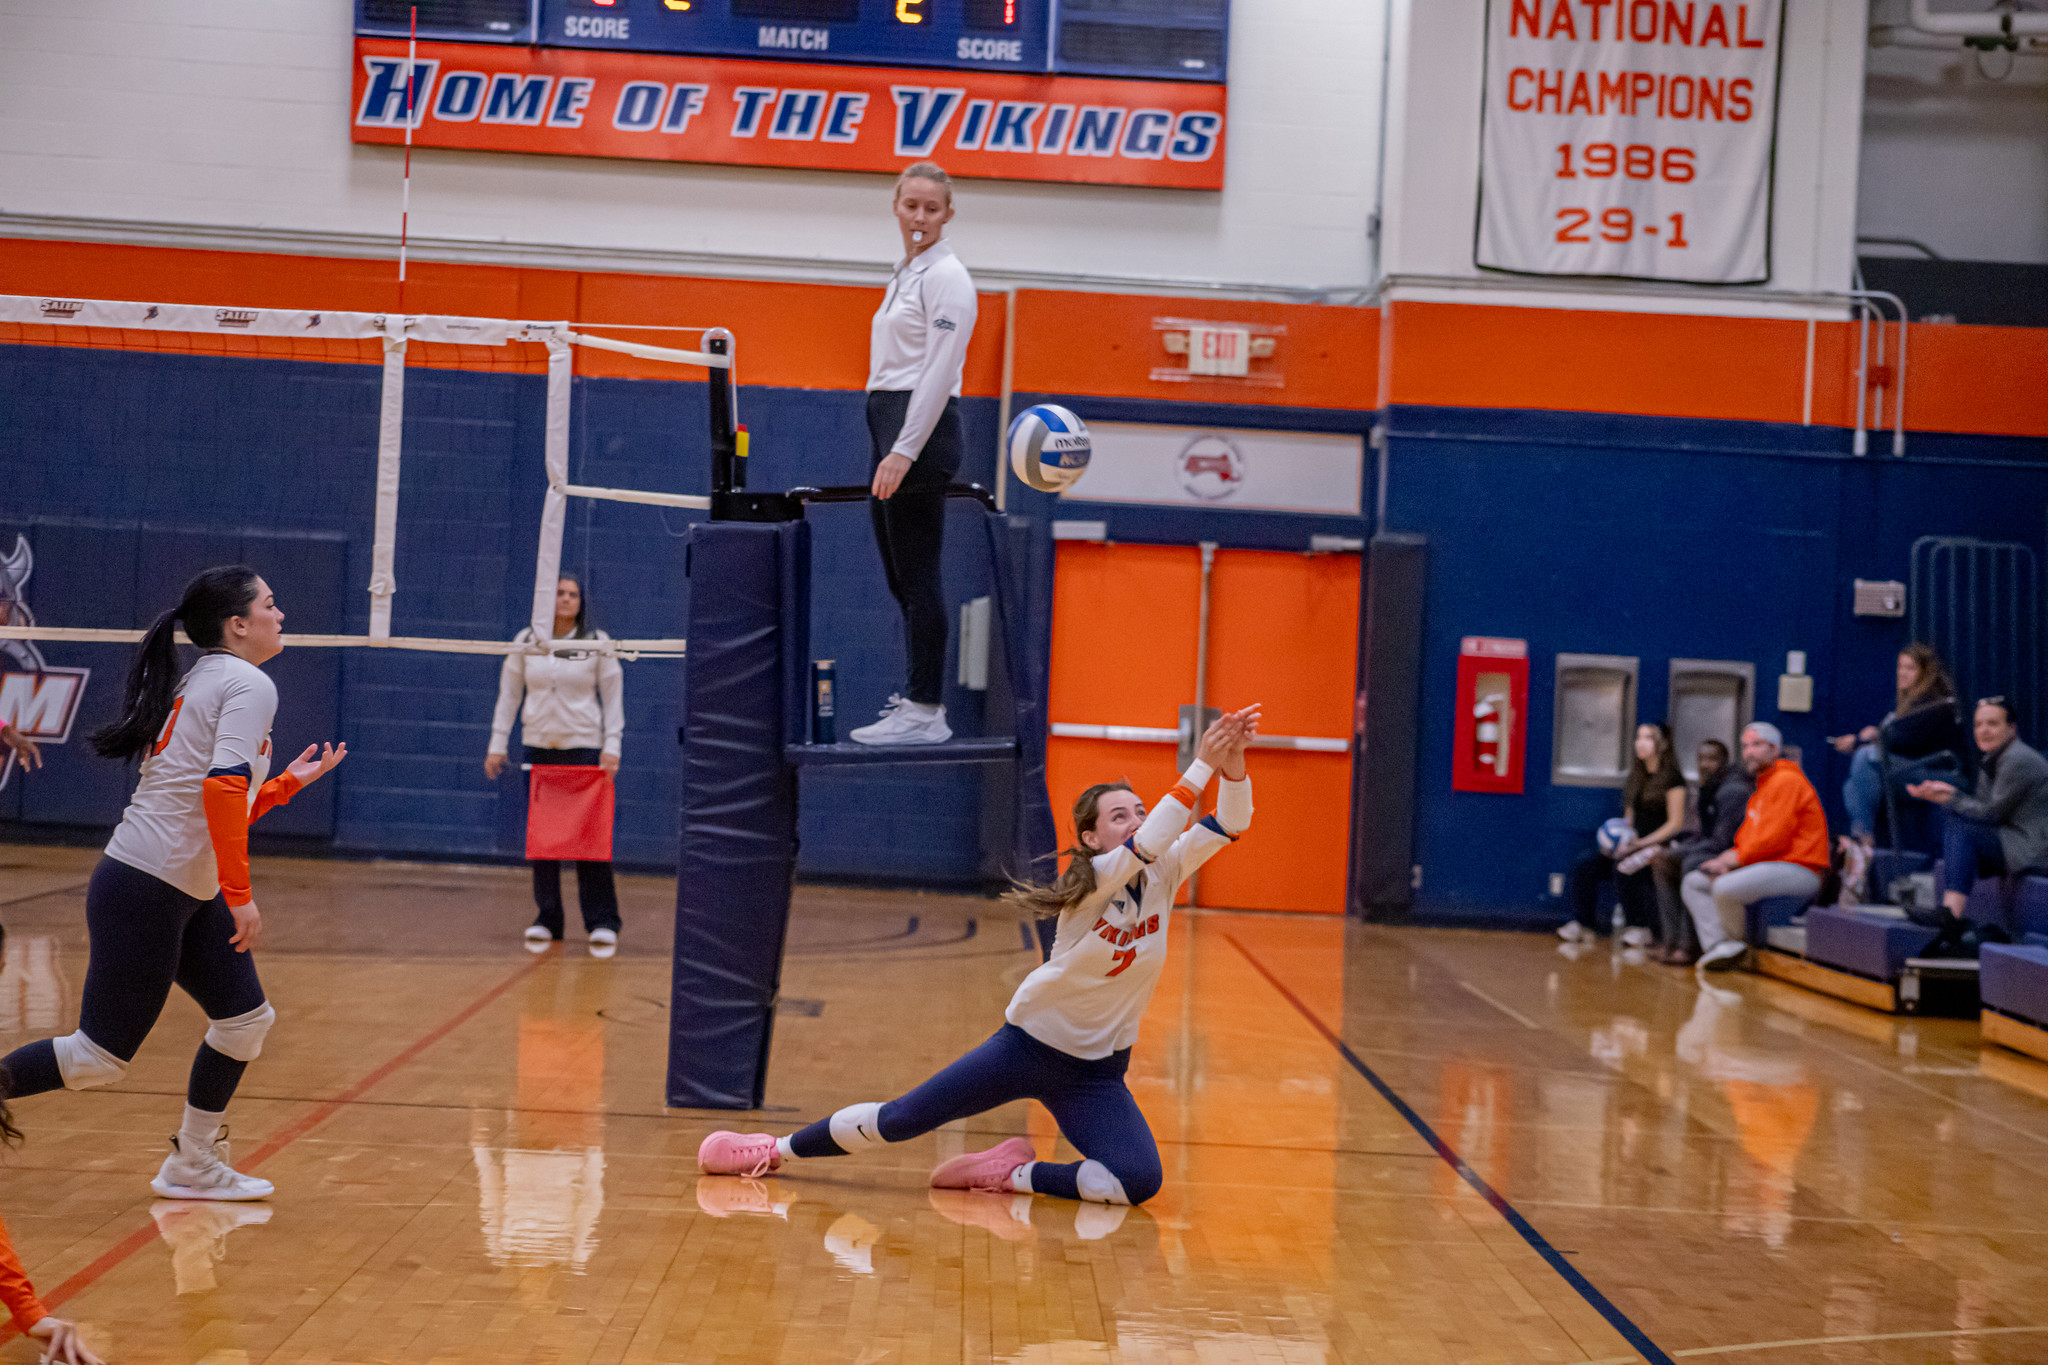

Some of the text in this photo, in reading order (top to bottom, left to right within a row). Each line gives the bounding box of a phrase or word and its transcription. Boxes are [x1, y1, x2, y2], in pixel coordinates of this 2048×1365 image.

[564, 16, 630, 39] SCORE
[758, 26, 829, 50] MATCH
[1509, 0, 1764, 48] NATIONAL
[957, 38, 1022, 61] SCORE
[355, 56, 1222, 162] HOME OF THE VIKINGS
[1507, 67, 1754, 123] CHAMPIONS
[1555, 143, 1697, 184] 1986
[1555, 207, 1688, 249] 29-1
[1105, 947, 1136, 977] 7
